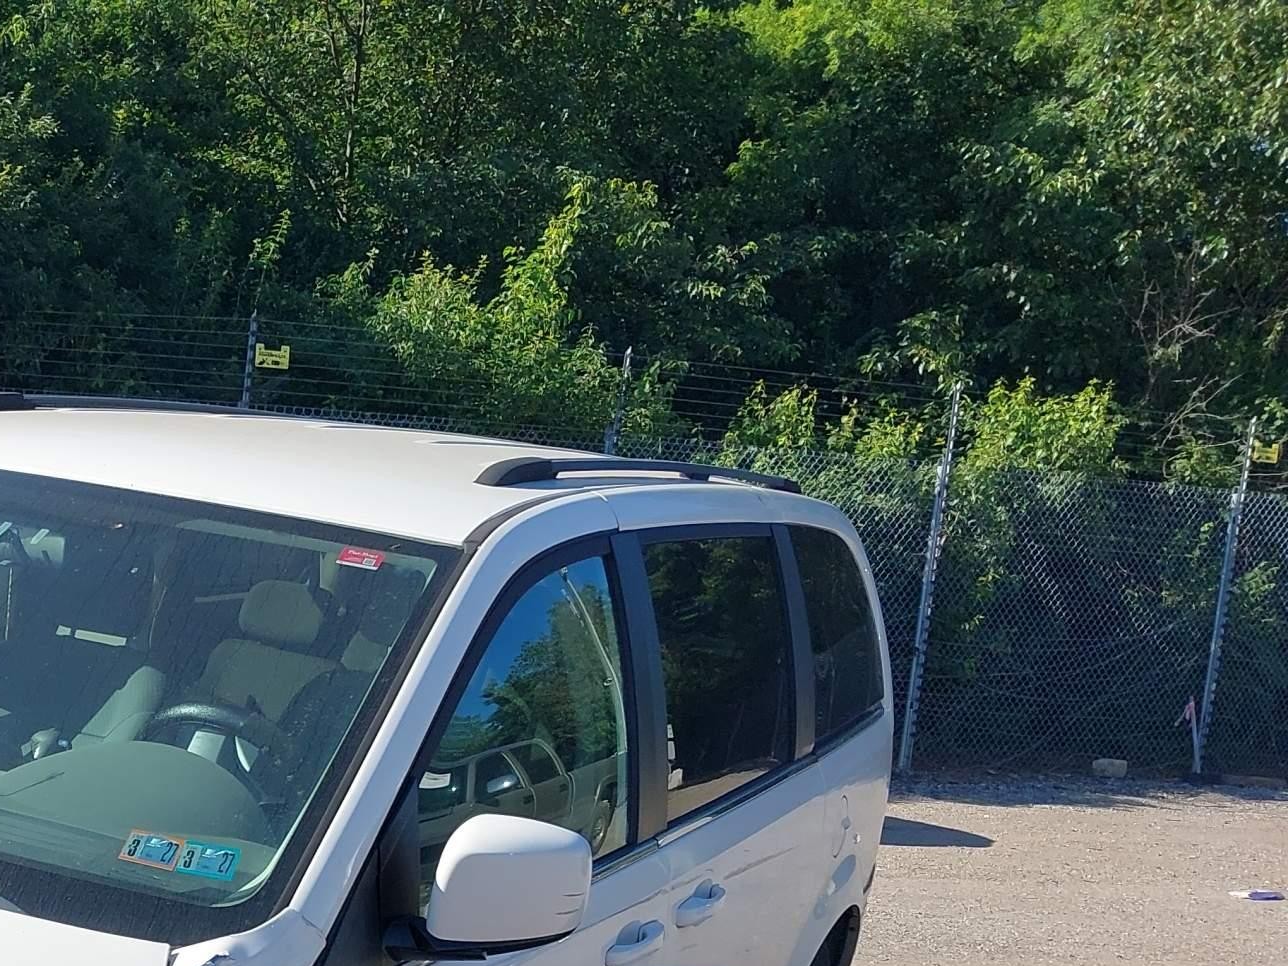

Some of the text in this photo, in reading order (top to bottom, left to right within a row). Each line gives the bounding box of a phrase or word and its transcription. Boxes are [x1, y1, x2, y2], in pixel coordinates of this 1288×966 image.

[127, 839, 179, 864] 3 27
[183, 850, 235, 874] 3 27
